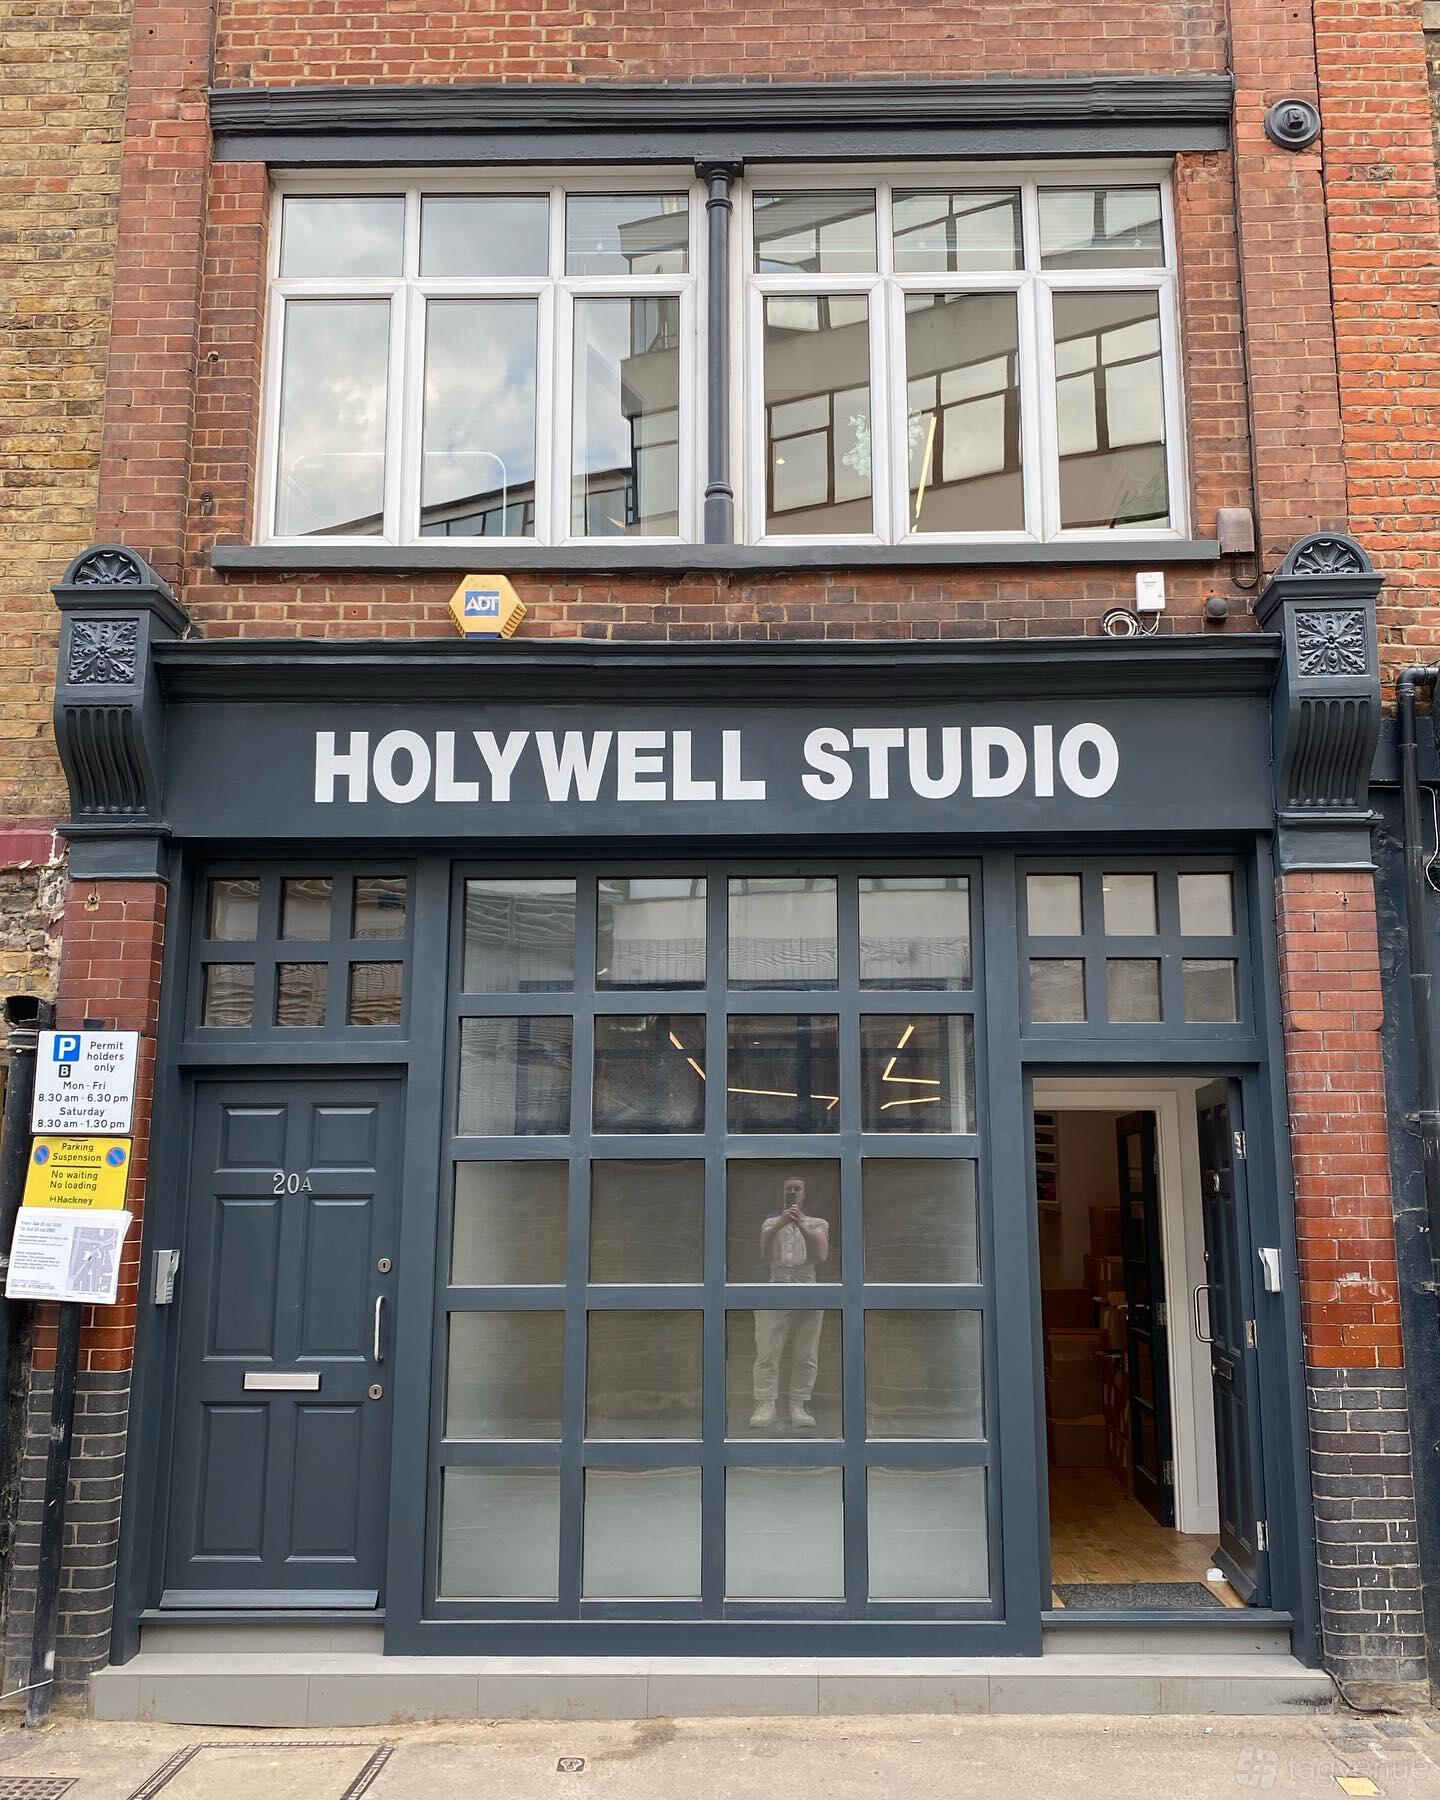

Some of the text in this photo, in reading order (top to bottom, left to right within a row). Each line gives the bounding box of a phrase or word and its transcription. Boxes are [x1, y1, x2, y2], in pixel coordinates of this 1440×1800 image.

[465, 595, 499, 611] ADT
[314, 722, 1120, 803] HOLYWELL STUDIO
[58, 1037, 76, 1060] P
[89, 1041, 124, 1050] Permit
[87, 1052, 125, 1061] holders
[60, 1066, 69, 1076] B
[94, 1063, 116, 1073] only
[63, 1081, 84, 1090] Mon
[92, 1081, 106, 1090] Fri
[38, 1093, 62, 1102] 8.30
[87, 1093, 111, 1102] 6.30
[113, 1096, 129, 1104] pm
[59, 1106, 105, 1117] Saturday
[37, 1119, 61, 1128] 8.30
[86, 1119, 108, 1128] 1.30
[110, 1121, 125, 1130] pm
[61, 1142, 94, 1151] Parking
[52, 1153, 102, 1162] Suspension
[51, 1170, 98, 1180] No waiting
[49, 1181, 97, 1191] No loading
[273, 1172, 312, 1194] 20A
[57, 1195, 94, 1206] Hackney
